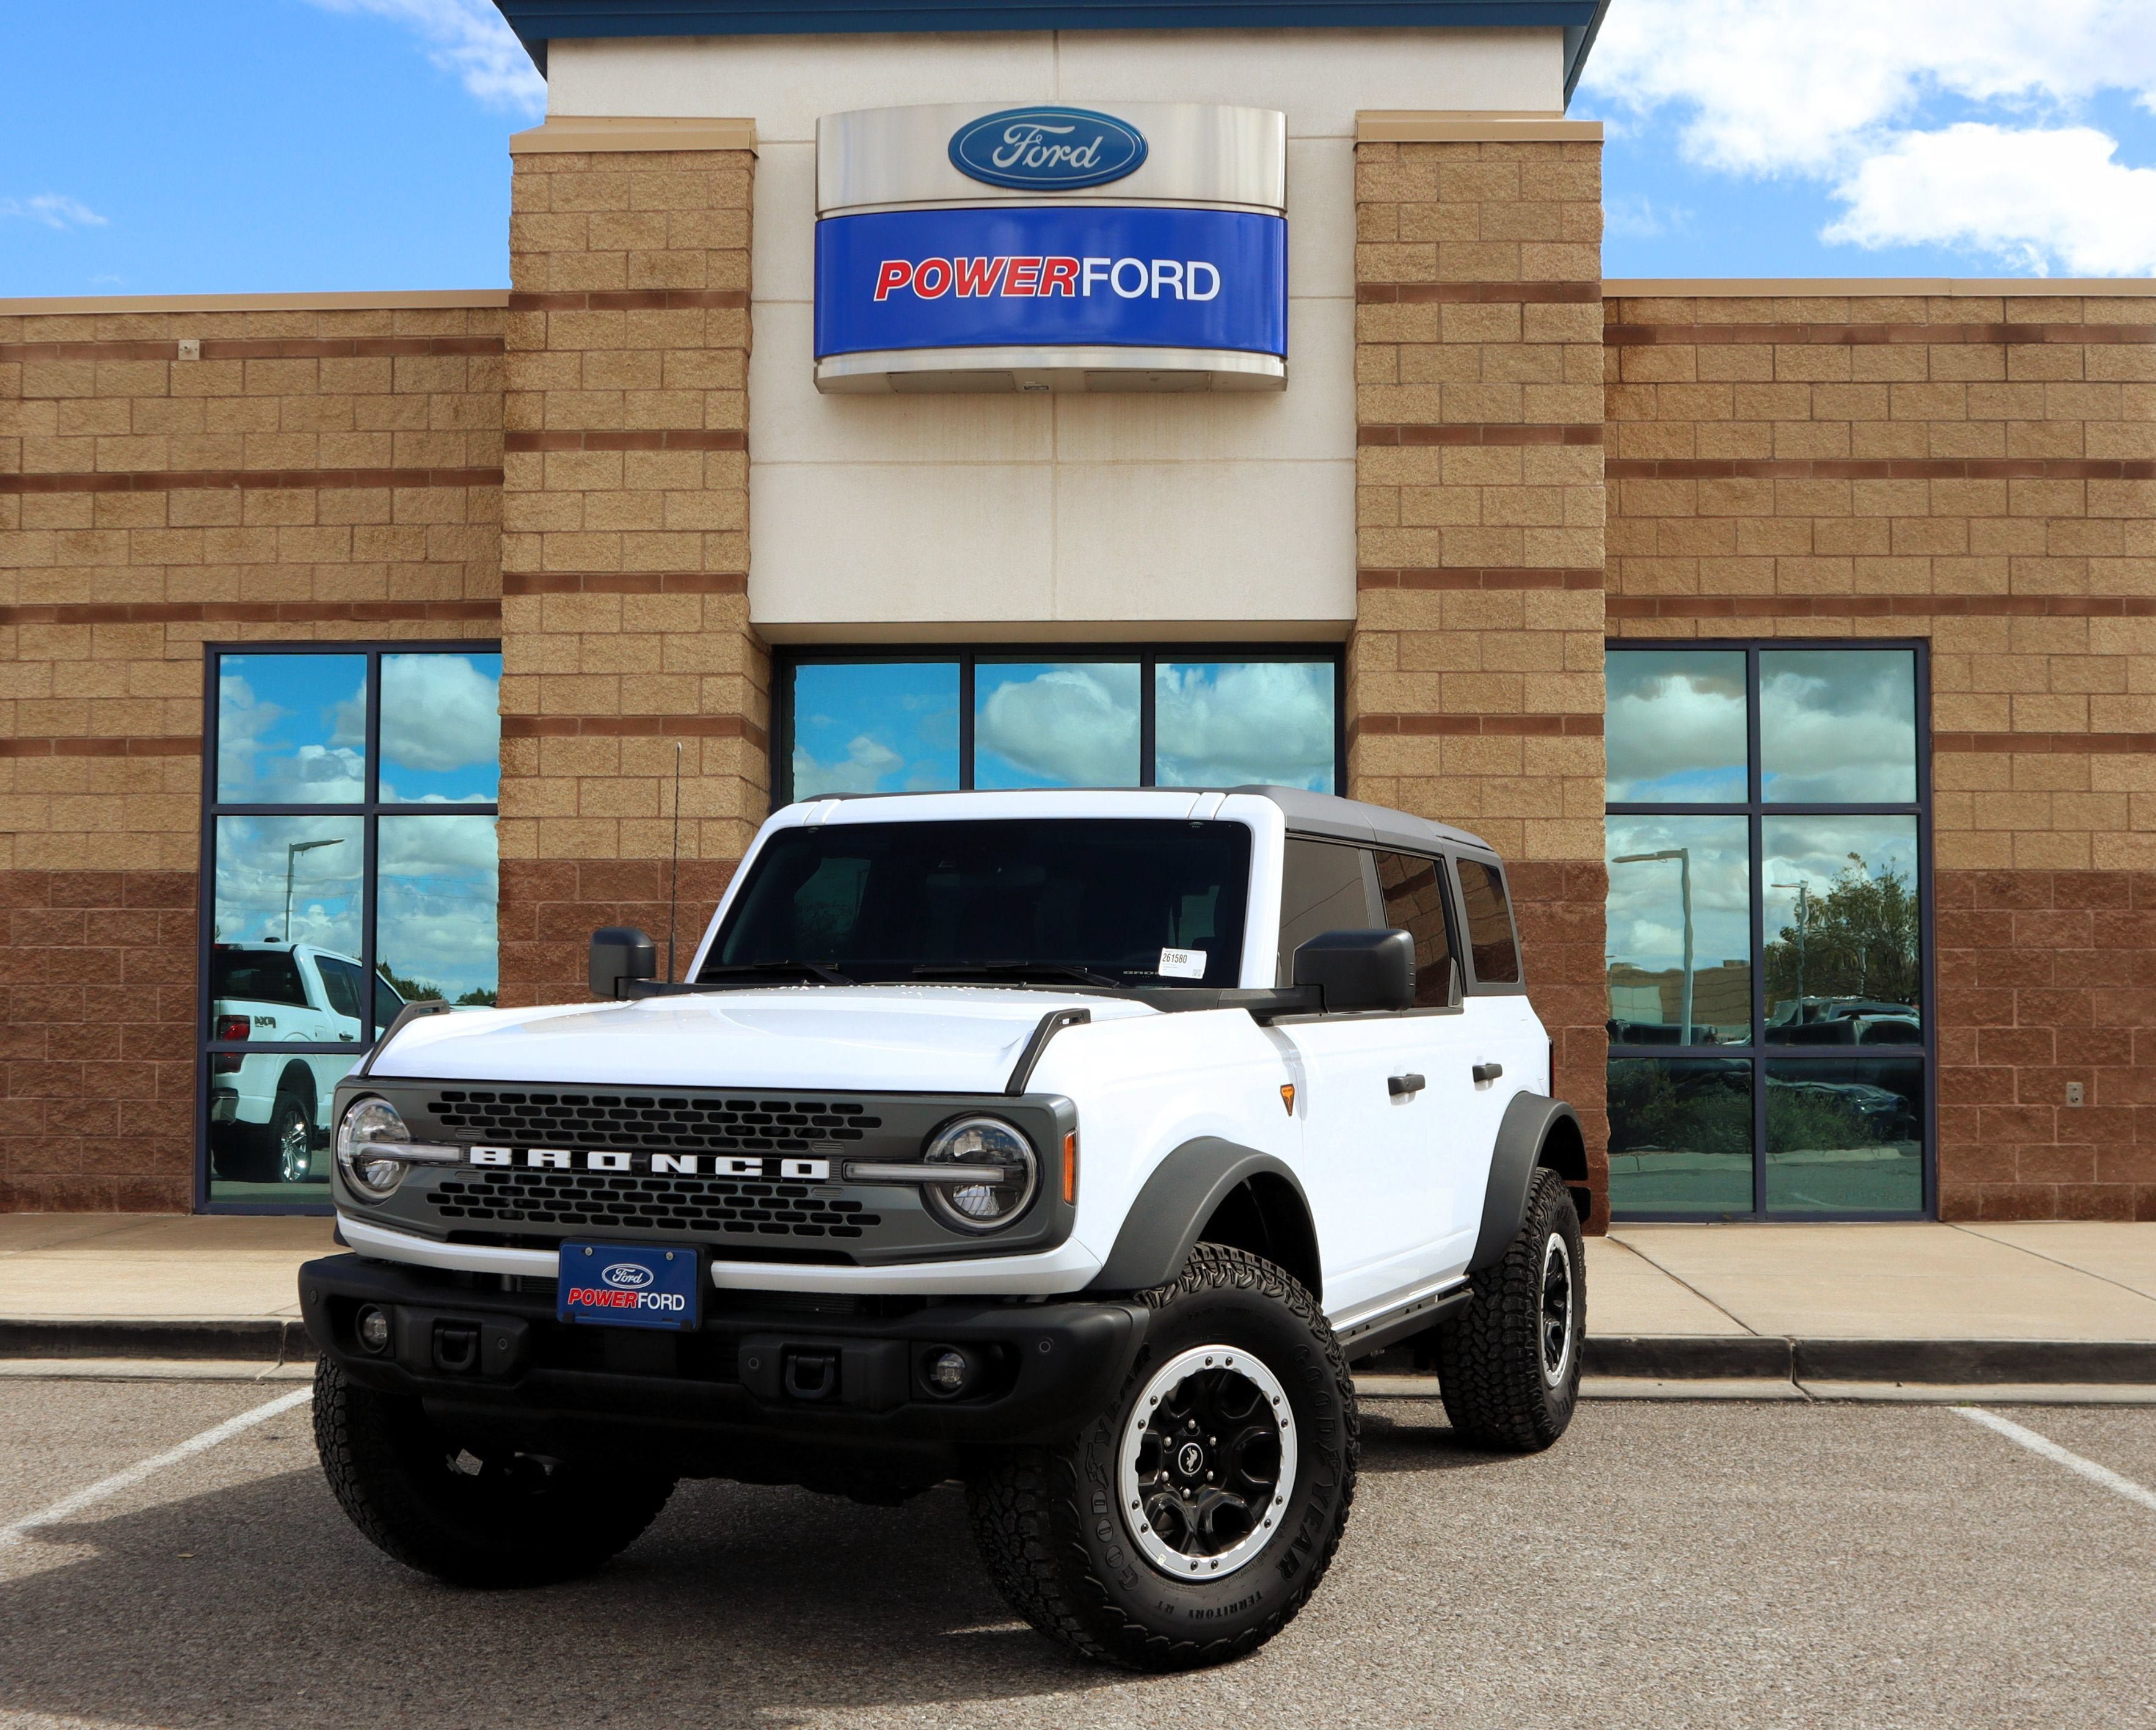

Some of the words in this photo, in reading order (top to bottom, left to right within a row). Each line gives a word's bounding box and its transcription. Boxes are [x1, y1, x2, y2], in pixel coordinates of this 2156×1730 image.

[992, 123, 1104, 169] Ford
[1162, 952, 1188, 963] 261580
[470, 1146, 830, 1179] BRONCO
[612, 1267, 643, 1284] Ford
[1187, 1590, 1264, 1619] TERRITORY
